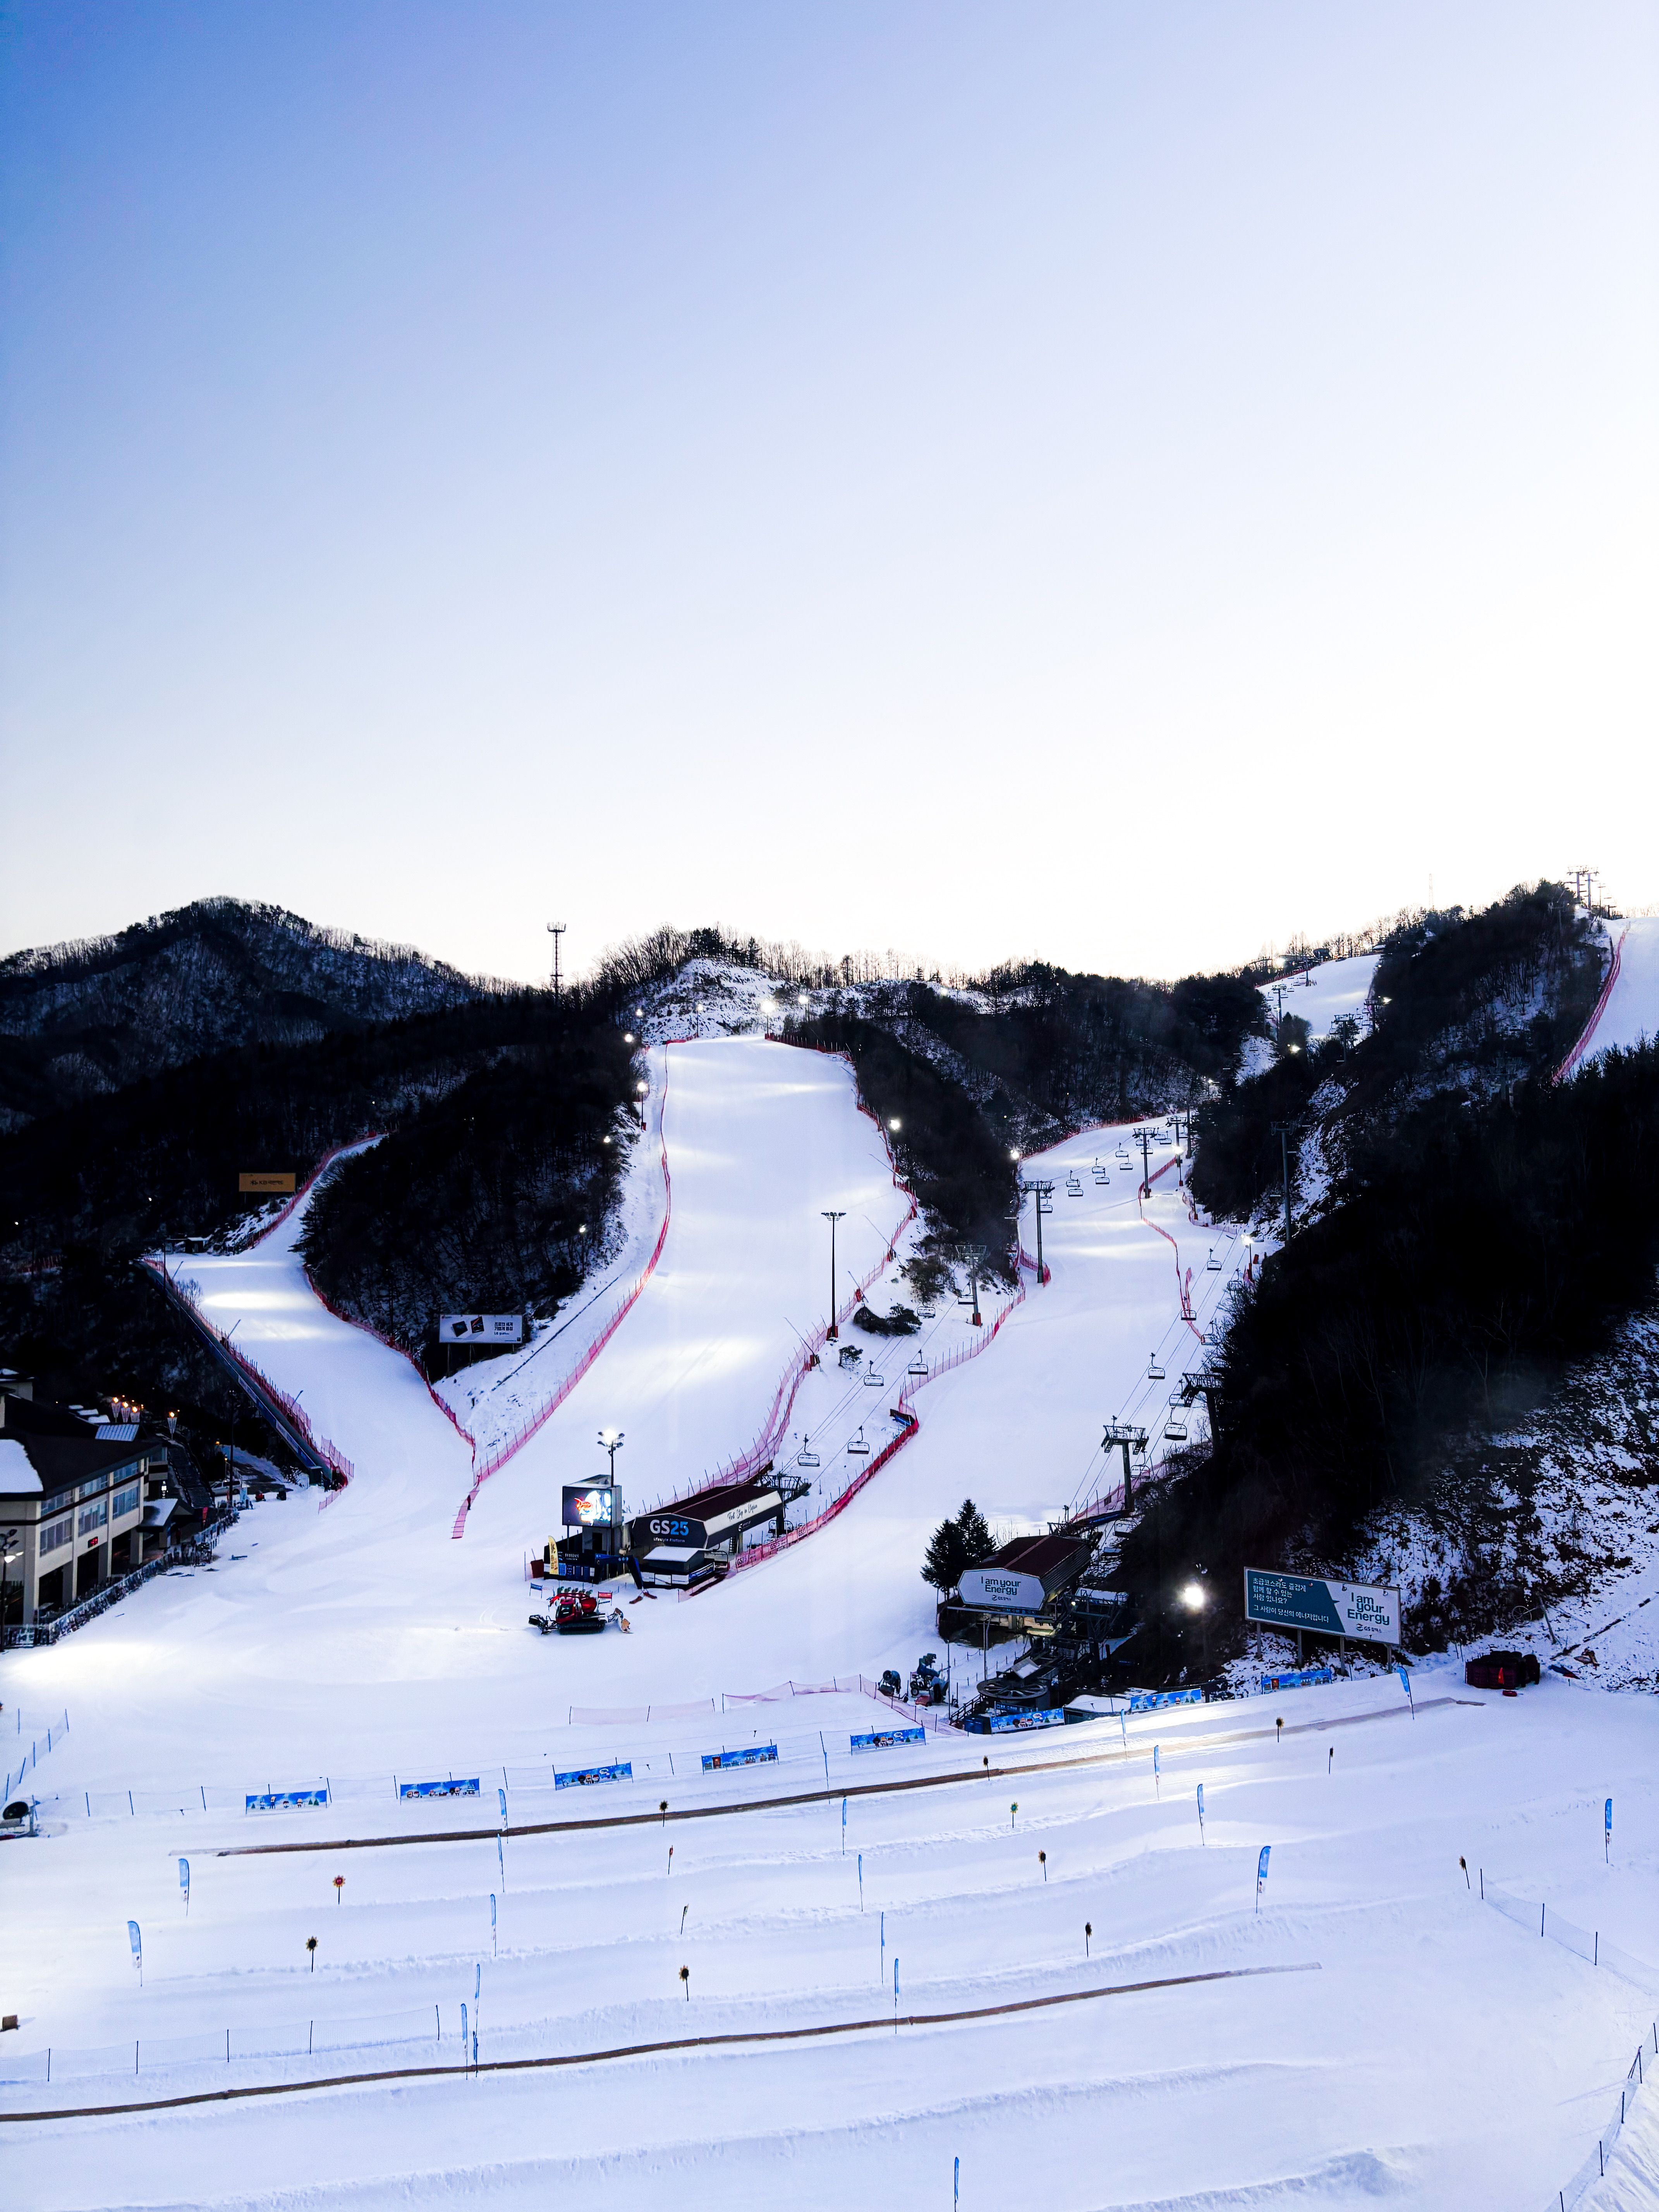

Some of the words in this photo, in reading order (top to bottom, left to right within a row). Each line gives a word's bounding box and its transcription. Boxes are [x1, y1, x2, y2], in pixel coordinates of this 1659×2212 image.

[650, 1519, 689, 1536] GS25
[985, 1584, 1017, 1595] Energy
[1281, 1590, 1293, 1598] 있는
[1266, 1595, 1287, 1604] 있나요?
[1351, 1592, 1354, 1602] I
[1356, 1595, 1374, 1604] am
[1356, 1602, 1384, 1613] your
[1260, 1606, 1276, 1614] 사람이
[1278, 1608, 1294, 1617] 당신의
[1295, 1611, 1329, 1623] 에너지입니다
[1347, 1608, 1390, 1625] Energy
